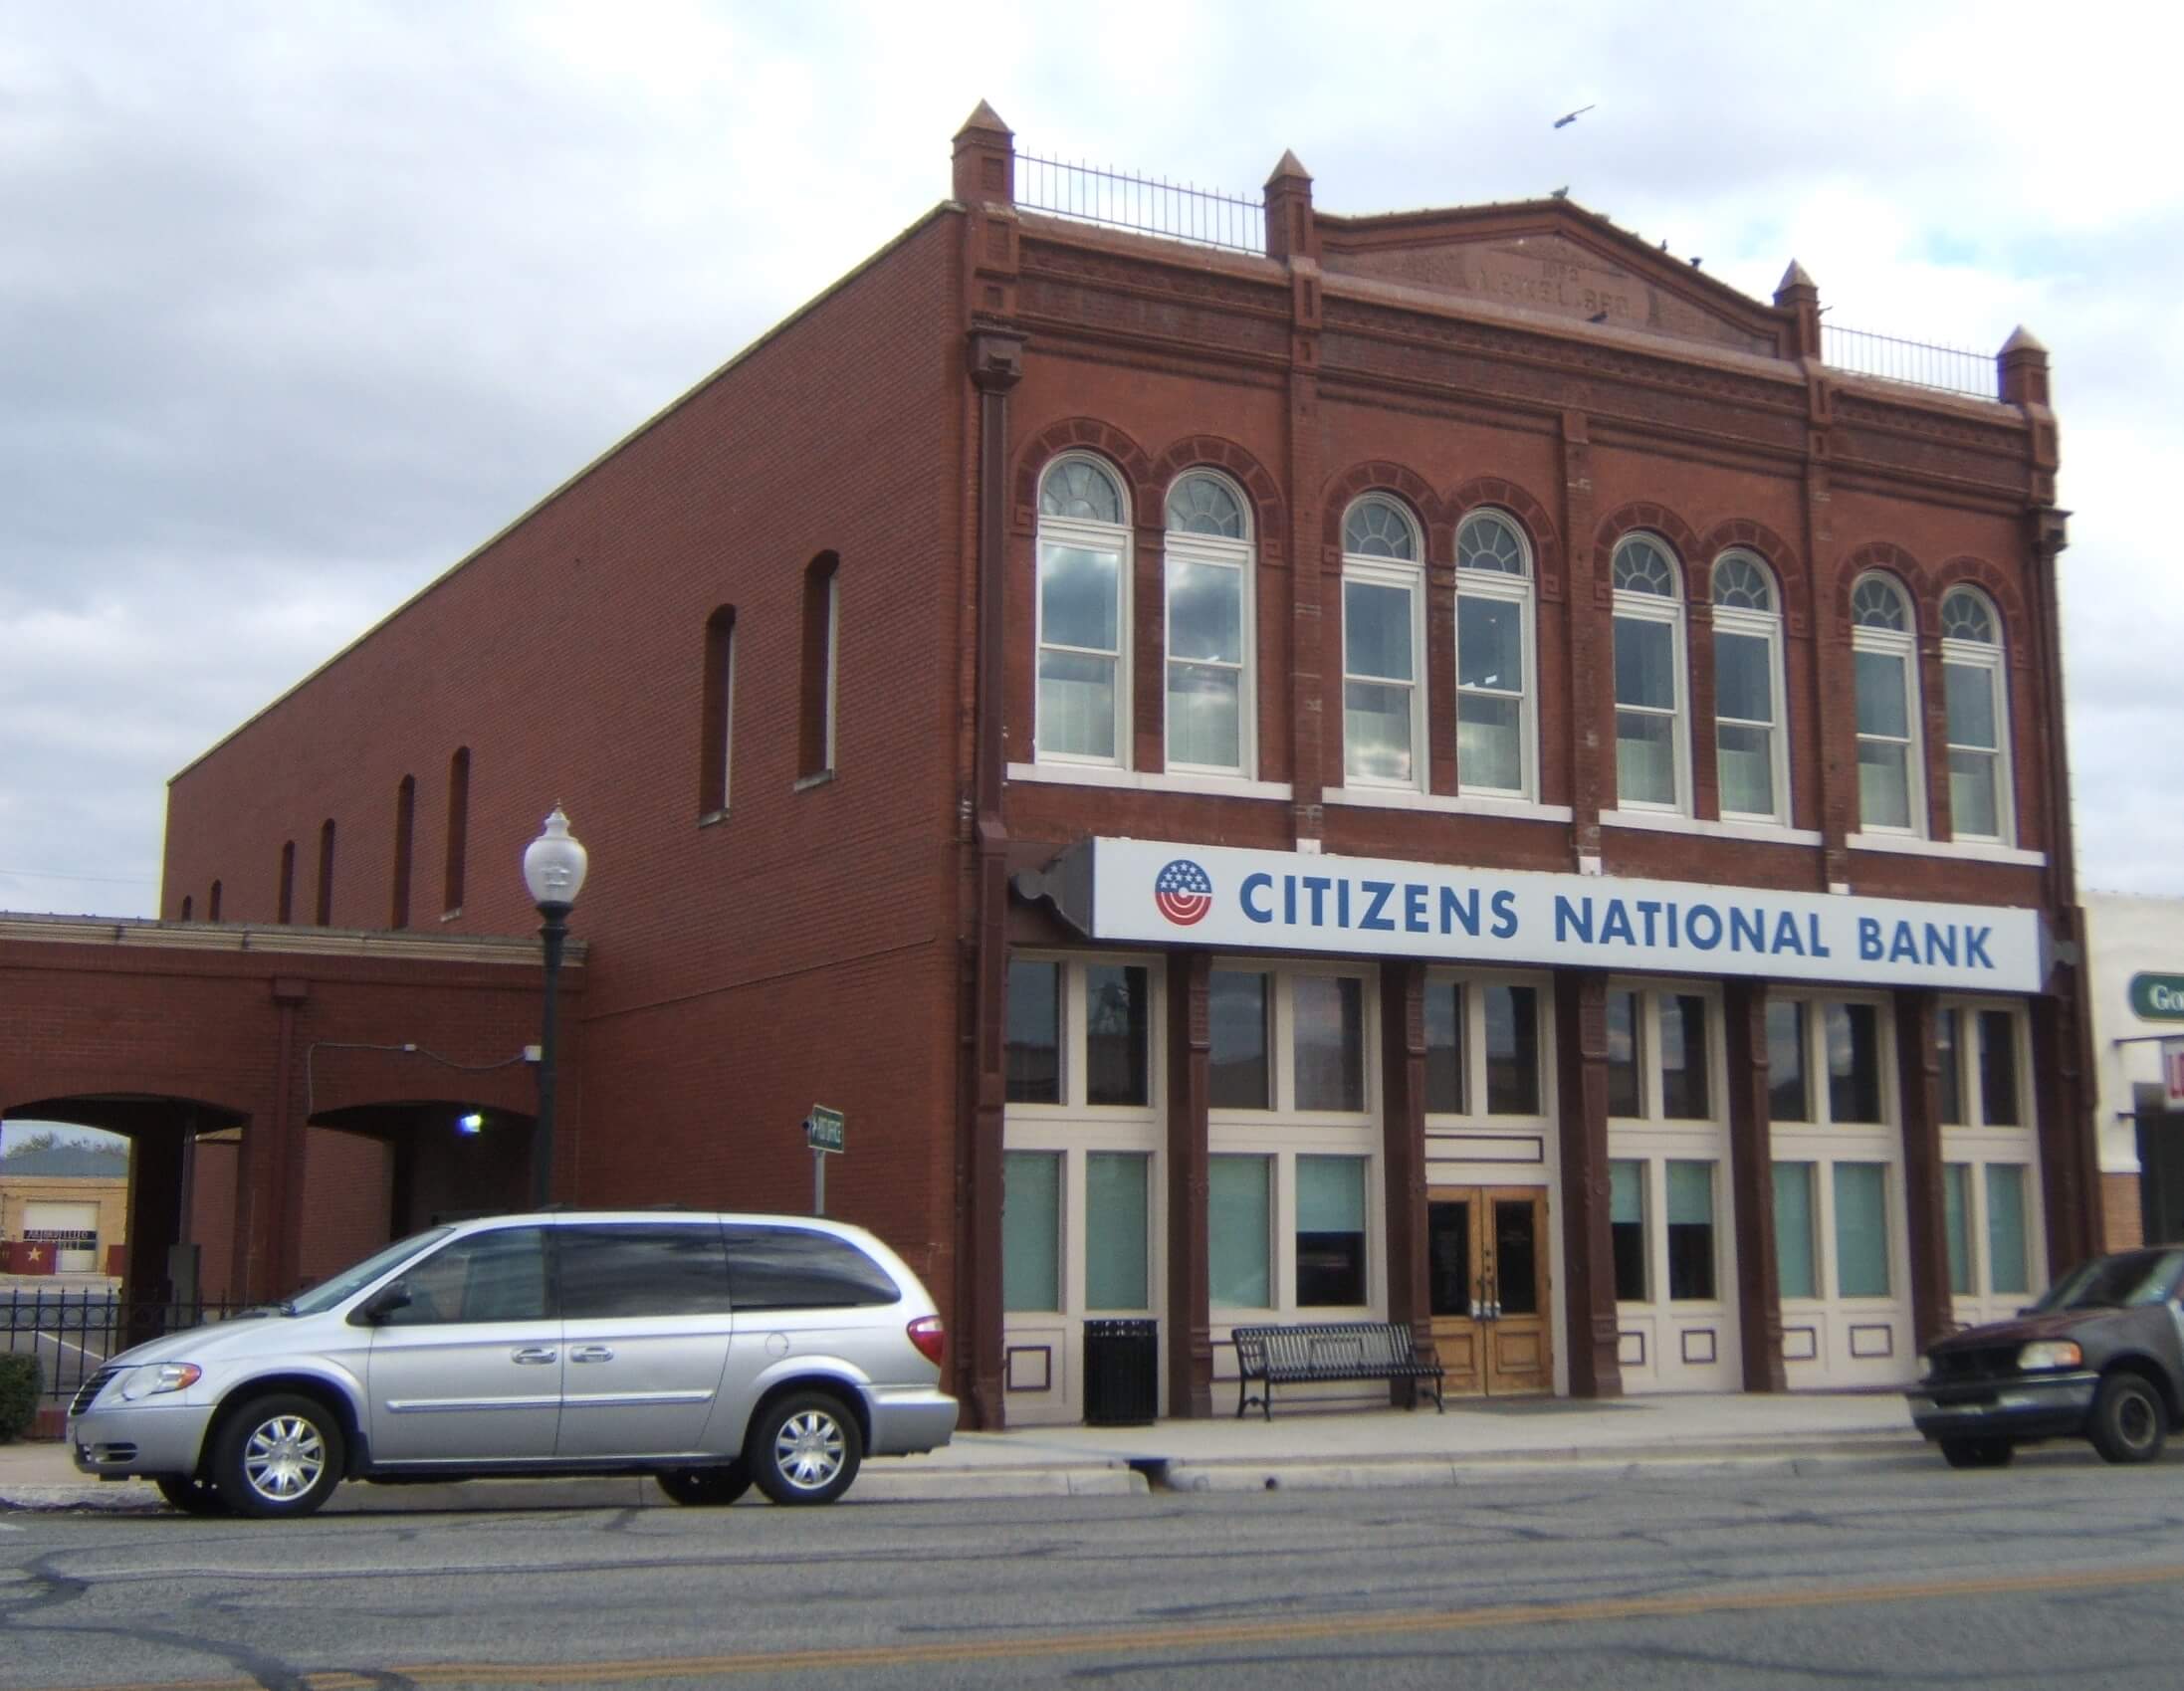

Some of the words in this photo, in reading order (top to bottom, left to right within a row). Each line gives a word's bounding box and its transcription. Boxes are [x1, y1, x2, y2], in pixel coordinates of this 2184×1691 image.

[1239, 872, 1519, 939] CITIZENS
[1555, 895, 1831, 958] NATIONAL
[1857, 917, 1996, 969] BANK
[2149, 984, 2184, 1012] Go
